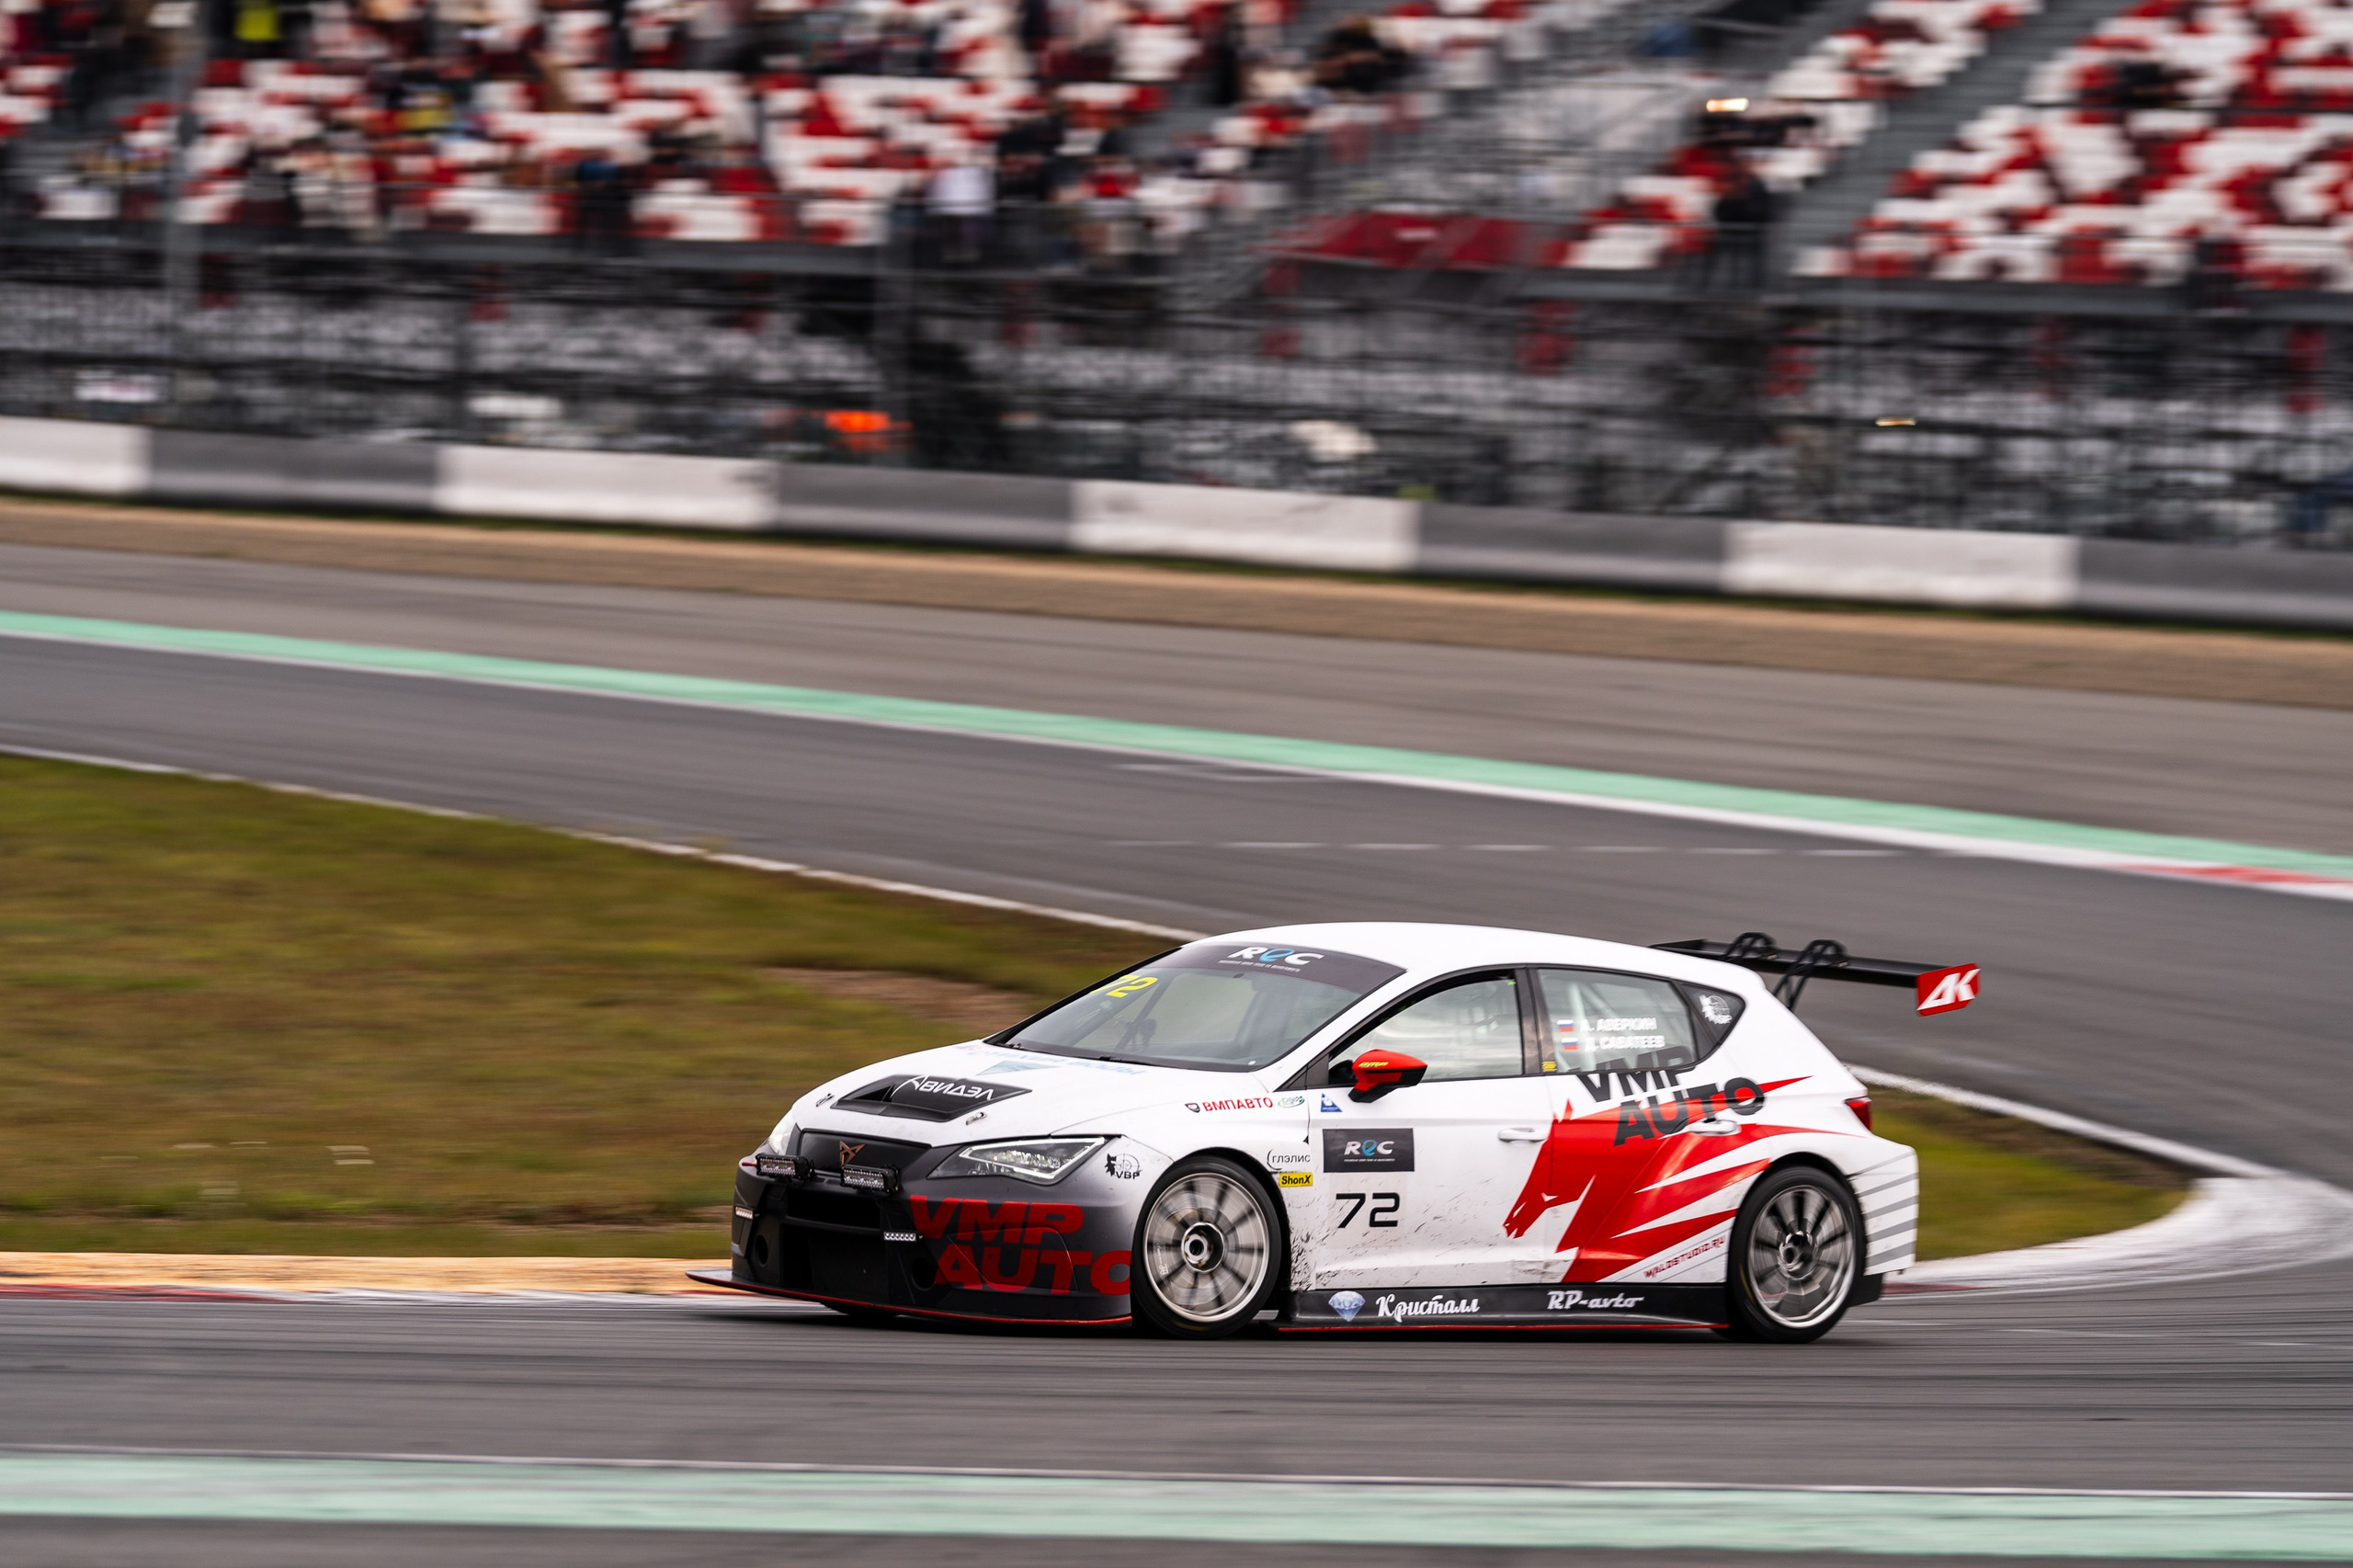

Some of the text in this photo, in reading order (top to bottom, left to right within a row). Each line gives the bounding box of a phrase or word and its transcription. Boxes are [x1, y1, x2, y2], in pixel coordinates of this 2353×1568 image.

[1090, 974, 1158, 998] 72
[1567, 1046, 1694, 1103] VMP
[1201, 1096, 1274, 1112] ВМПАВТО
[1612, 1077, 1766, 1146] AUTO
[1115, 1170, 1141, 1180] VBP
[1281, 1174, 1312, 1186] ShonX
[909, 1194, 1085, 1244] VMP
[1336, 1192, 1400, 1228] 72
[934, 1243, 1132, 1297] AUTO
[1375, 1292, 1481, 1324] Кристалл
[1546, 1290, 1646, 1311] RP-avto
